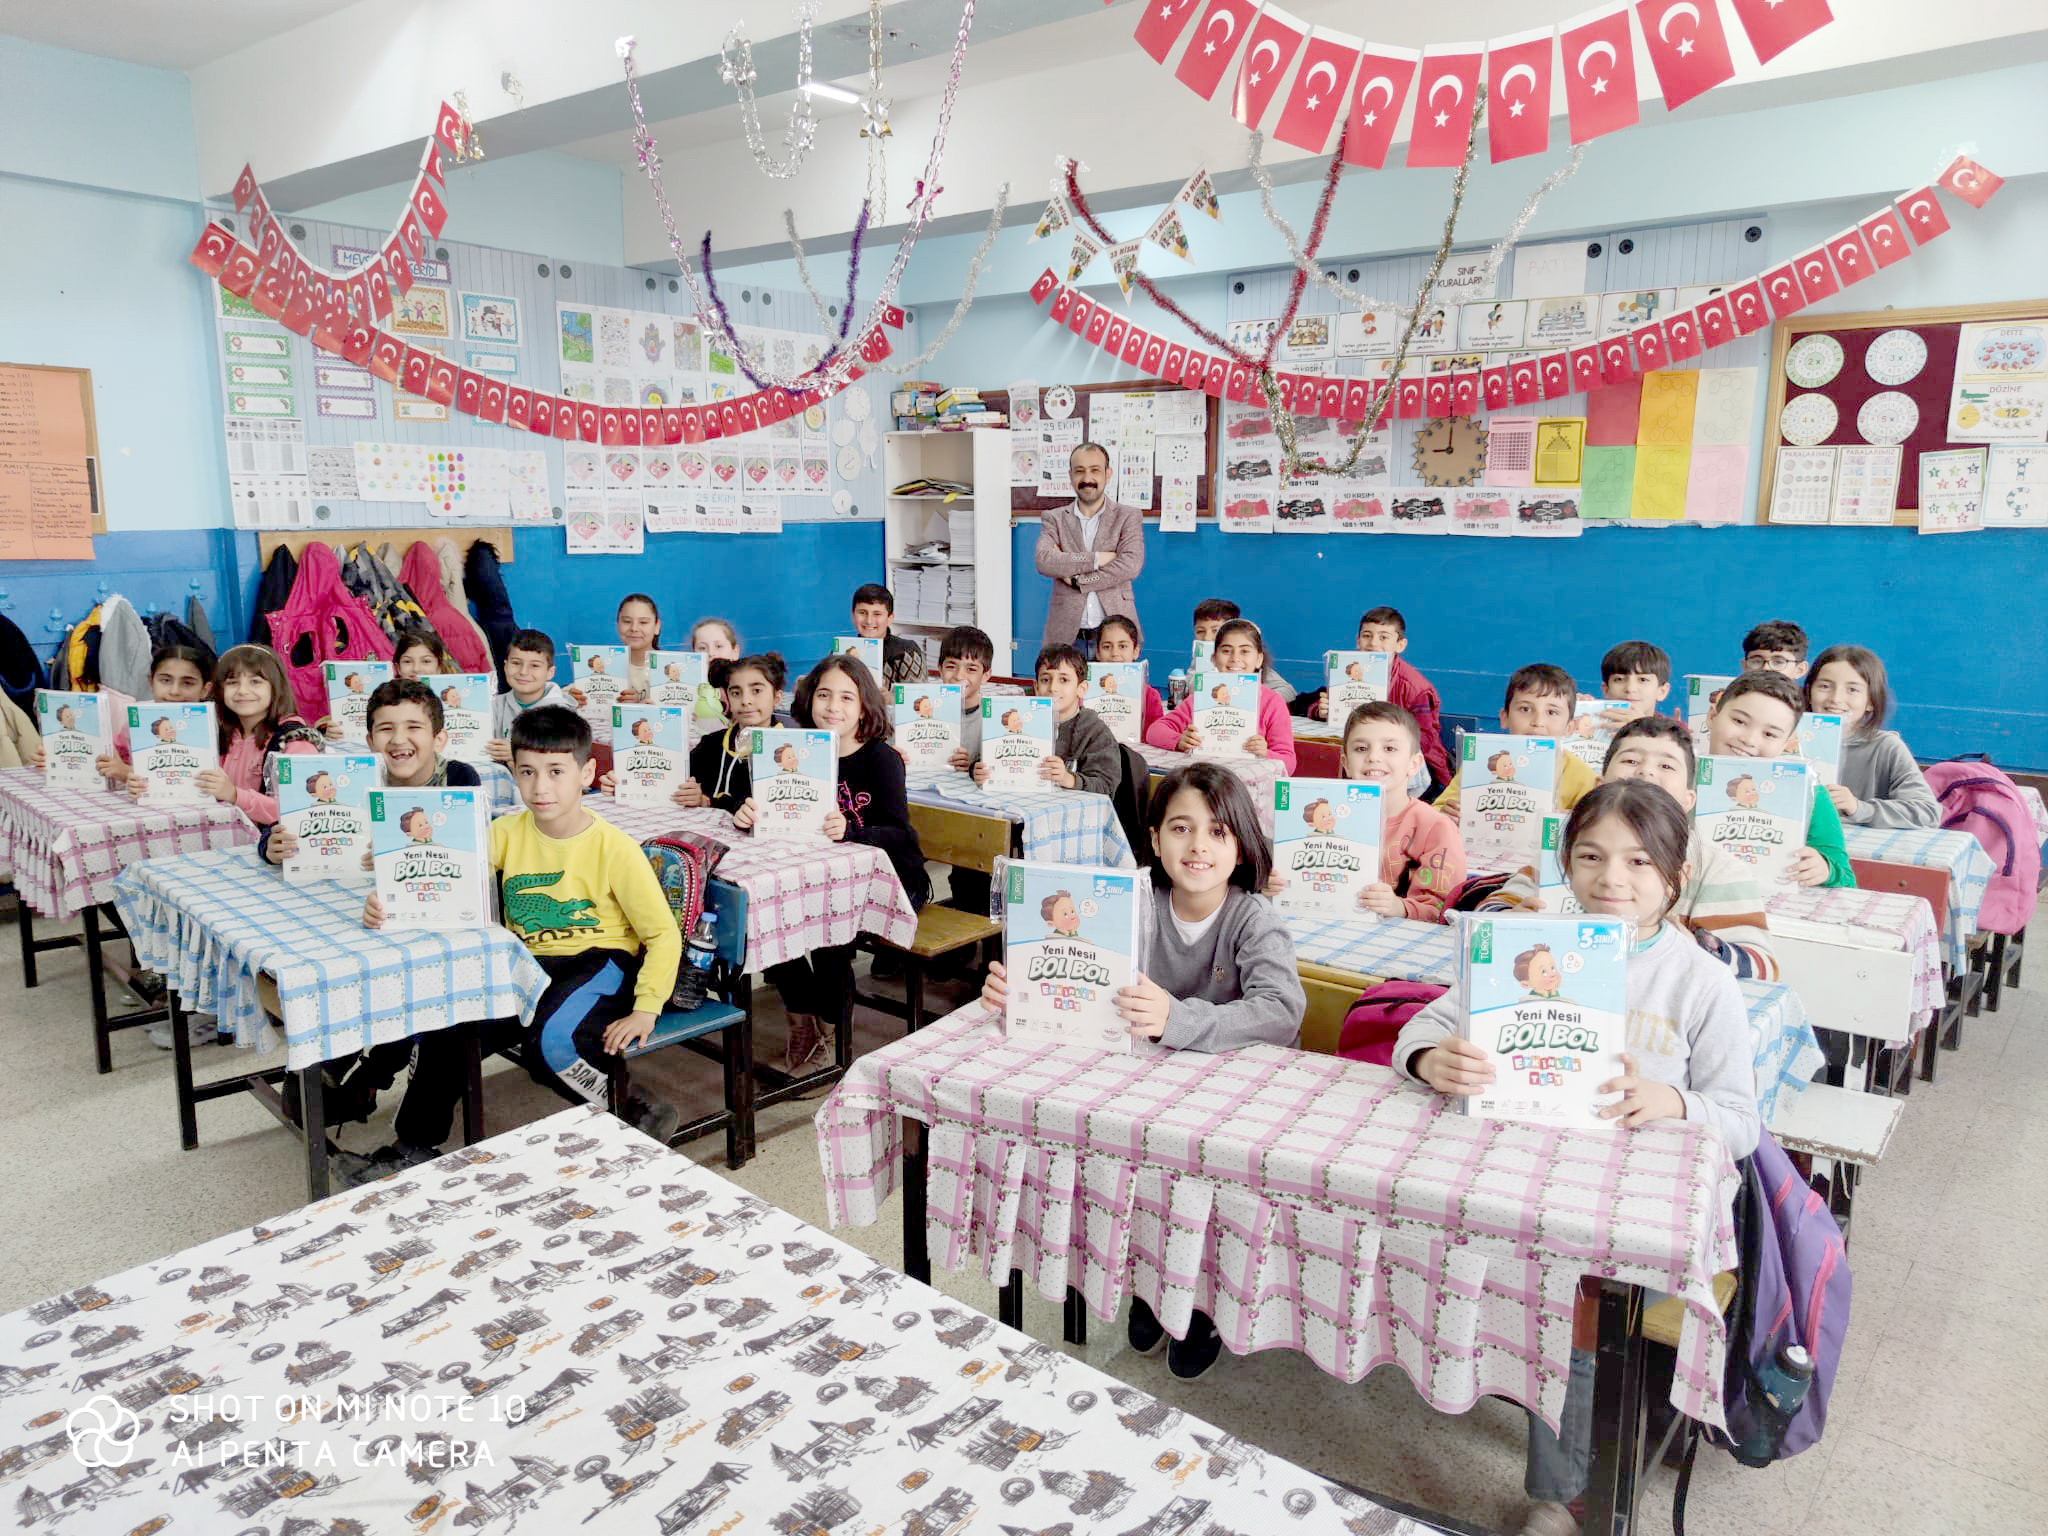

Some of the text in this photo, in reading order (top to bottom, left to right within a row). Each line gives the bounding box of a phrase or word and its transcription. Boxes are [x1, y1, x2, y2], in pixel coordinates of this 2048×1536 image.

[2002, 351, 2013, 360] 10
[2005, 408, 2020, 418] 12
[1043, 422, 1055, 431] 29
[341, 702, 360, 715] BOL
[907, 728, 950, 742] BOL BOL
[995, 745, 1041, 760] BOL BOL
[147, 754, 200, 771] BOL BOL
[626, 755, 672, 771] BOL BOL
[767, 786, 819, 803] BOL BOL
[1348, 787, 1361, 803] 3.
[1487, 786, 1527, 797] Yeni Nesil
[442, 794, 455, 810] 3.
[1476, 794, 1536, 813] BOL BOL
[309, 809, 351, 818] Yeni Nesil
[1748, 815, 1772, 826] Nesil
[299, 818, 362, 838] BOL BOL
[1712, 823, 1784, 845] BOL BOL
[403, 850, 449, 860] Yeni Nesil
[1303, 842, 1349, 852] Yeni Nesil
[1291, 850, 1361, 872] BOL BOL
[394, 860, 463, 882] BOL BOL
[1015, 871, 1024, 901] TÜRKÇE
[1093, 879, 1110, 899] 3.
[1480, 925, 1491, 961] TÜRKÇE
[1579, 927, 1616, 949] 3. SINIF
[1041, 945, 1097, 961] Yeni Nesil
[1028, 956, 1111, 987] BOL BOL
[1514, 1008, 1581, 1024] Yeni Nesil
[1496, 1022, 1600, 1054] BOL BOL
[1511, 1054, 1582, 1073] ETKİNLİK
[1529, 1071, 1564, 1087] TEST
